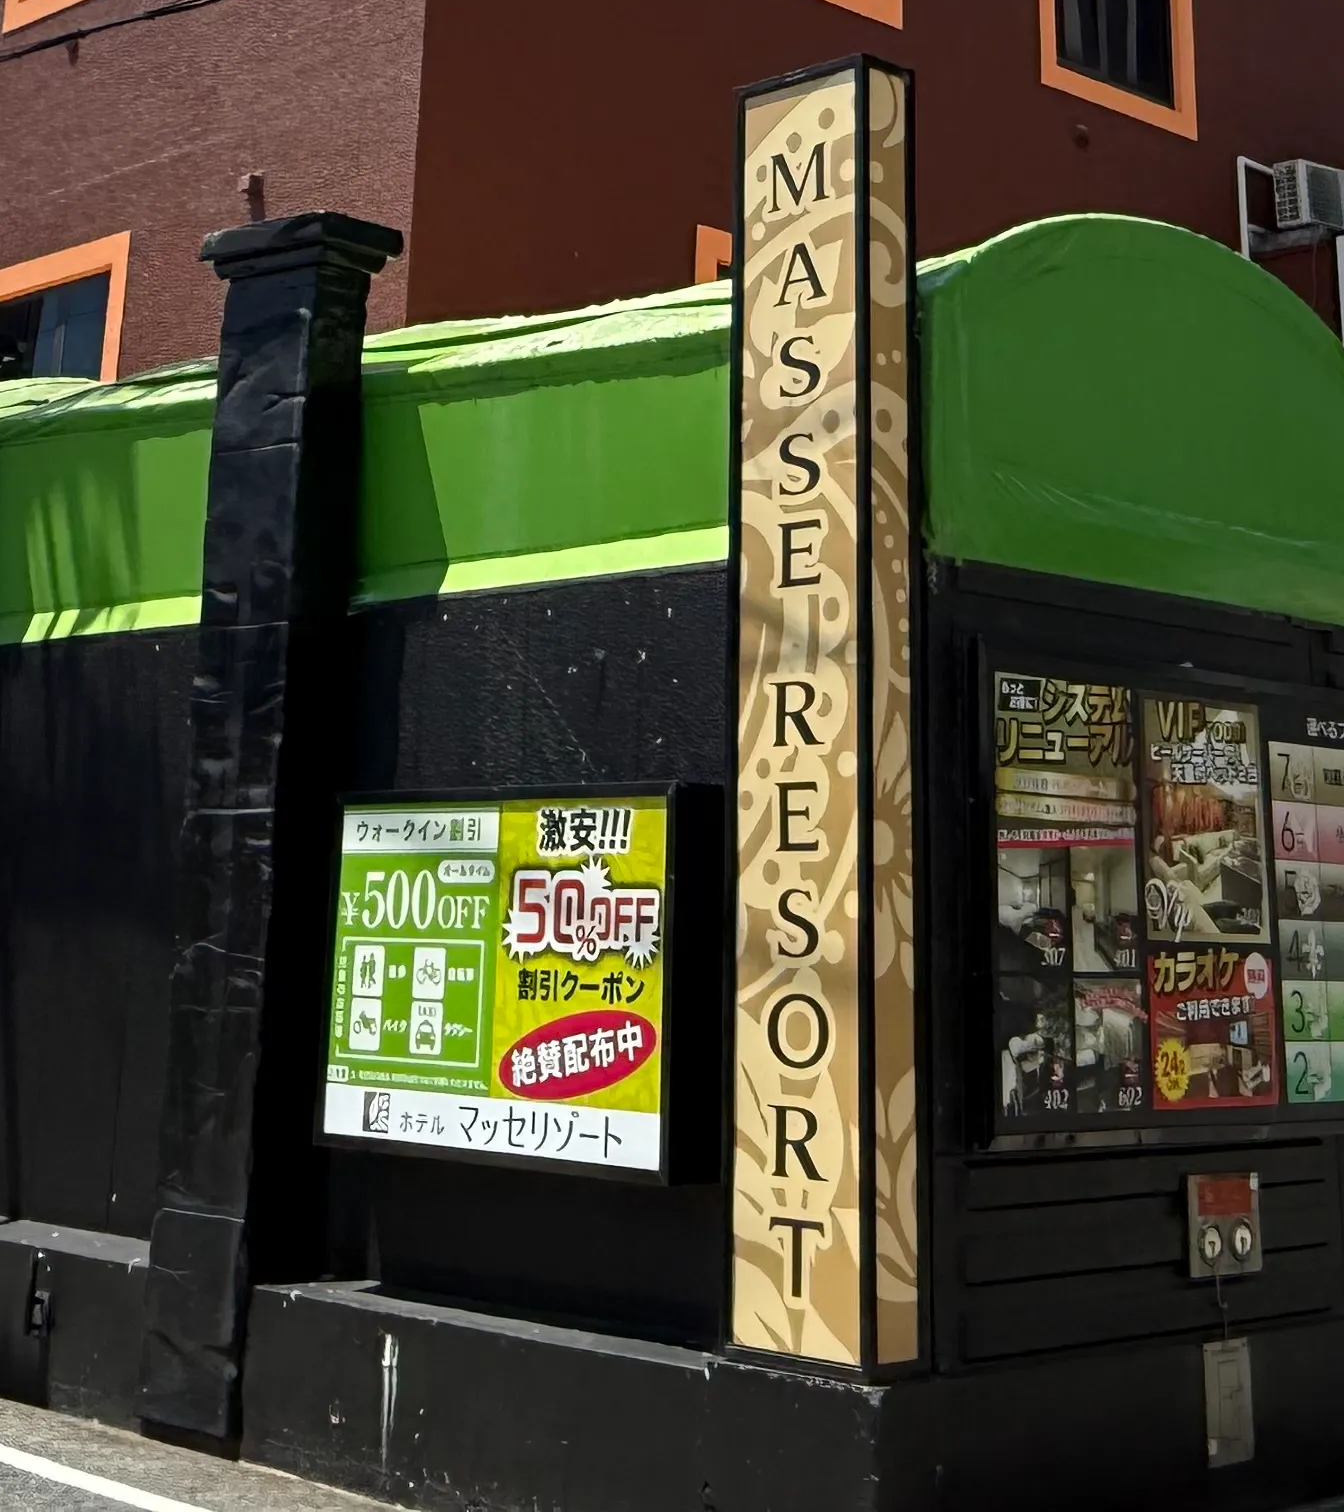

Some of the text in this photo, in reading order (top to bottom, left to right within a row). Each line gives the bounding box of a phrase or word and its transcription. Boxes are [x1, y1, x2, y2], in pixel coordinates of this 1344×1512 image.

[767, 140, 831, 1298] MASSE RESORT
[996, 717, 1134, 767] リニューアル
[517, 968, 645, 1004] 割引クーポン
[1155, 947, 1239, 993] カラオケ
[511, 1020, 644, 1087] 絶賛配布中
[399, 1105, 622, 1158] ホテル マッセリゾート
